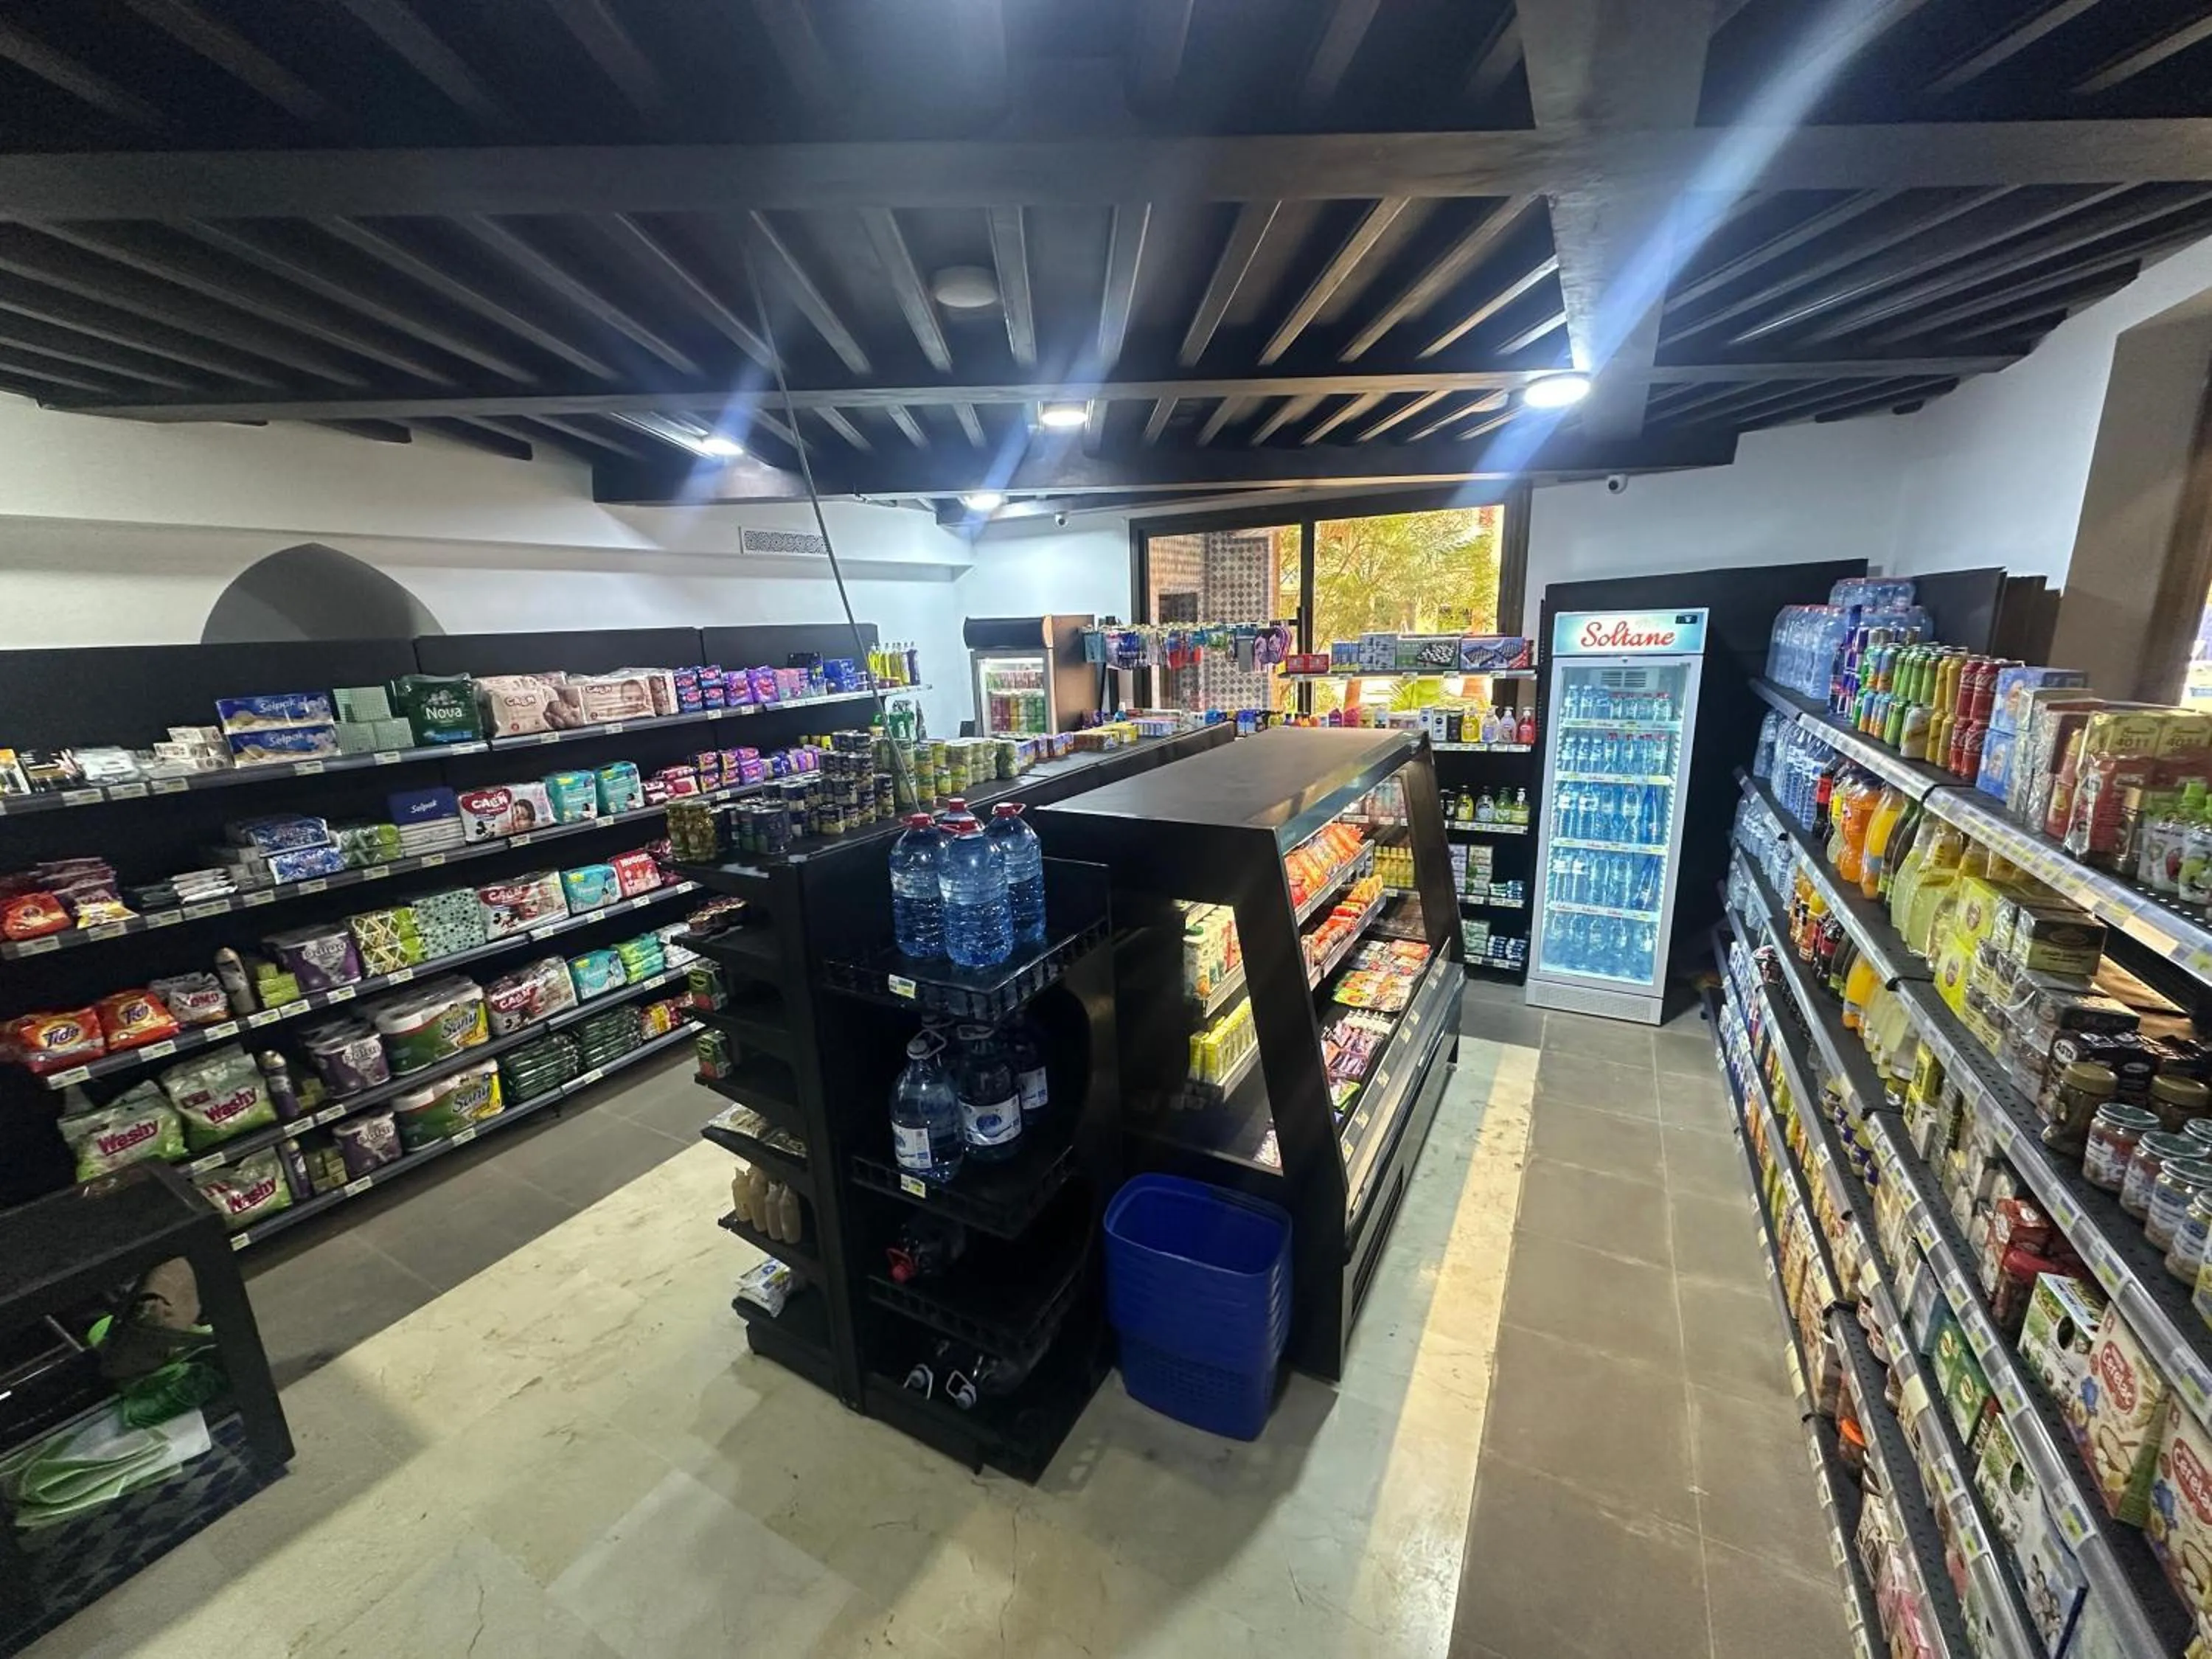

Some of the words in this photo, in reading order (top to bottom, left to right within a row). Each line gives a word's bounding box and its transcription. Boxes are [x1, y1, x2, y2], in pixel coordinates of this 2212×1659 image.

[1580, 621, 1676, 647] Soltane
[425, 706, 462, 720] Nova
[268, 730, 305, 747] Selpak
[410, 799, 438, 813] Selpak
[43, 1026, 80, 1048] Tide
[204, 1087, 257, 1124] Washy
[96, 1119, 159, 1156] Washy
[226, 1177, 276, 1215] Washy
[2102, 1347, 2134, 1406] Cerelac
